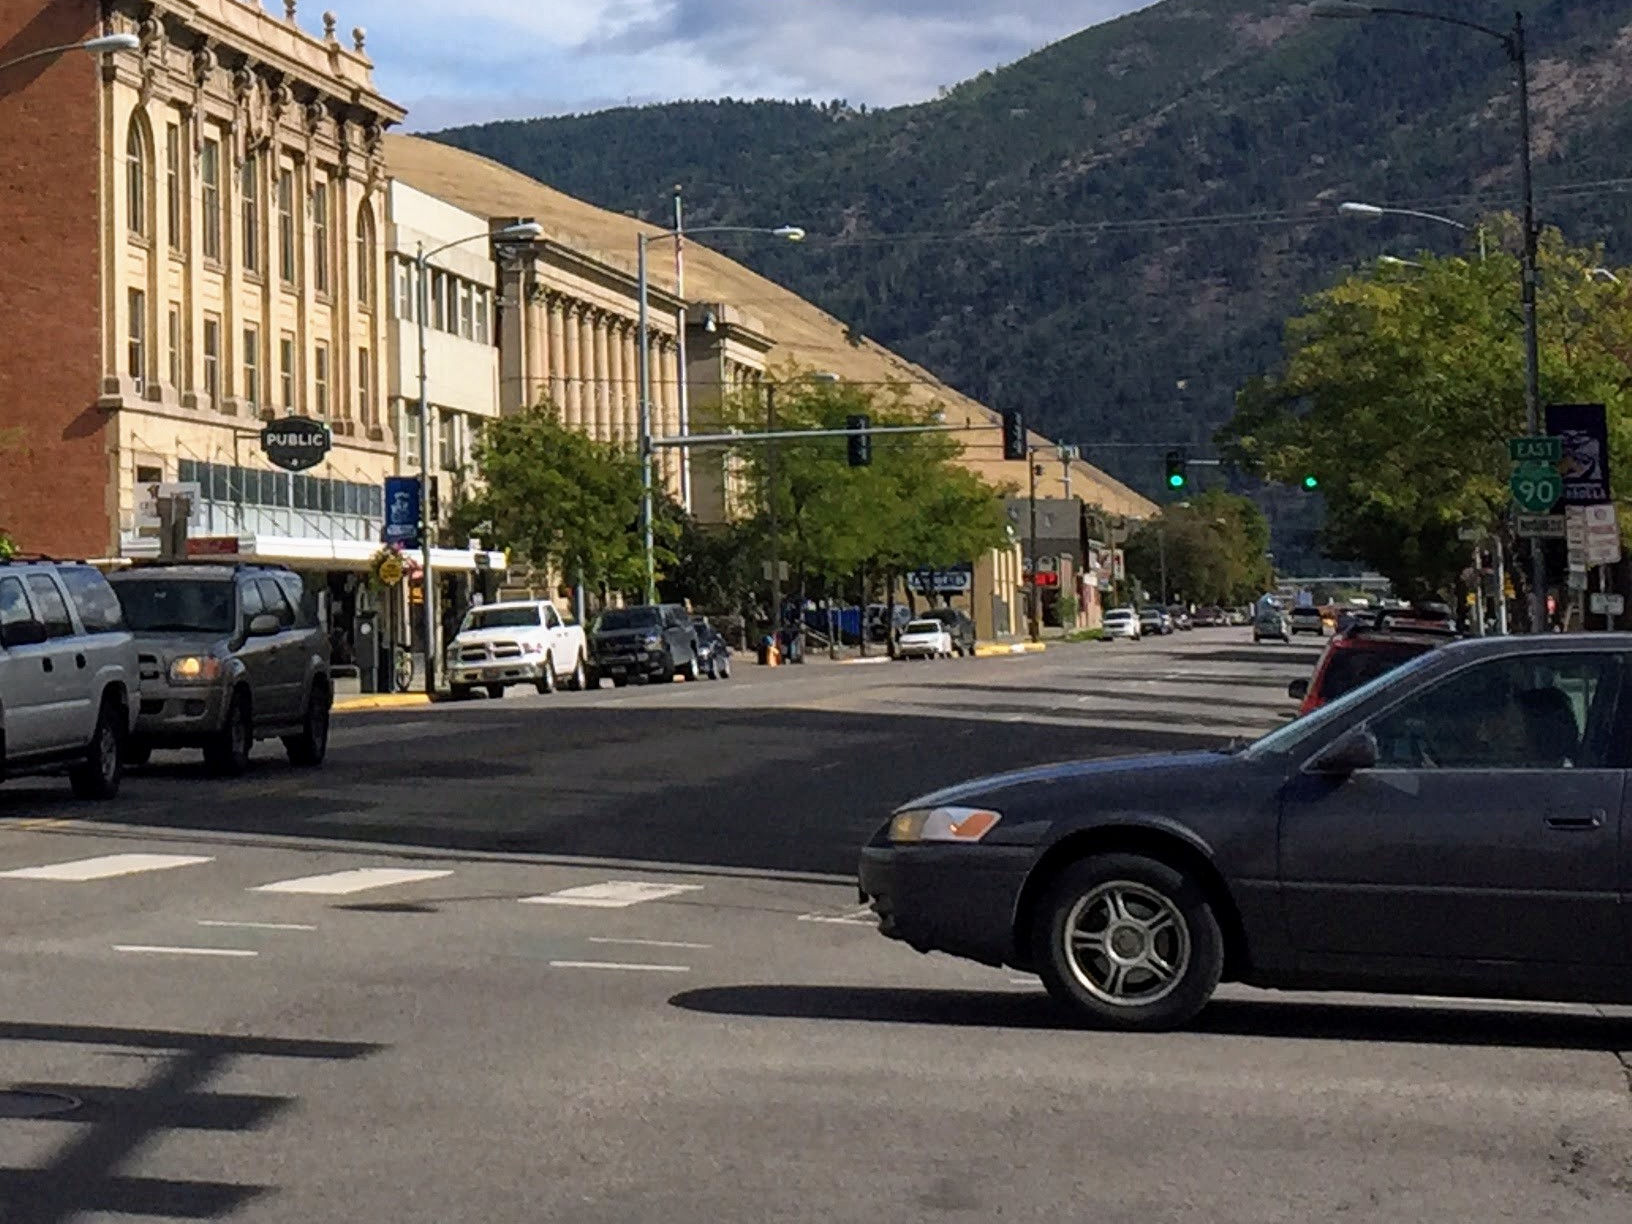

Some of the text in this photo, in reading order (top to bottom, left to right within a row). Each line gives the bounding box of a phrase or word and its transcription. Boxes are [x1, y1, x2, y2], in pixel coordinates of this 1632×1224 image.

[266, 433, 323, 446] PUBLIC
[1518, 442, 1553, 457] EAST
[1519, 481, 1554, 504] 90
